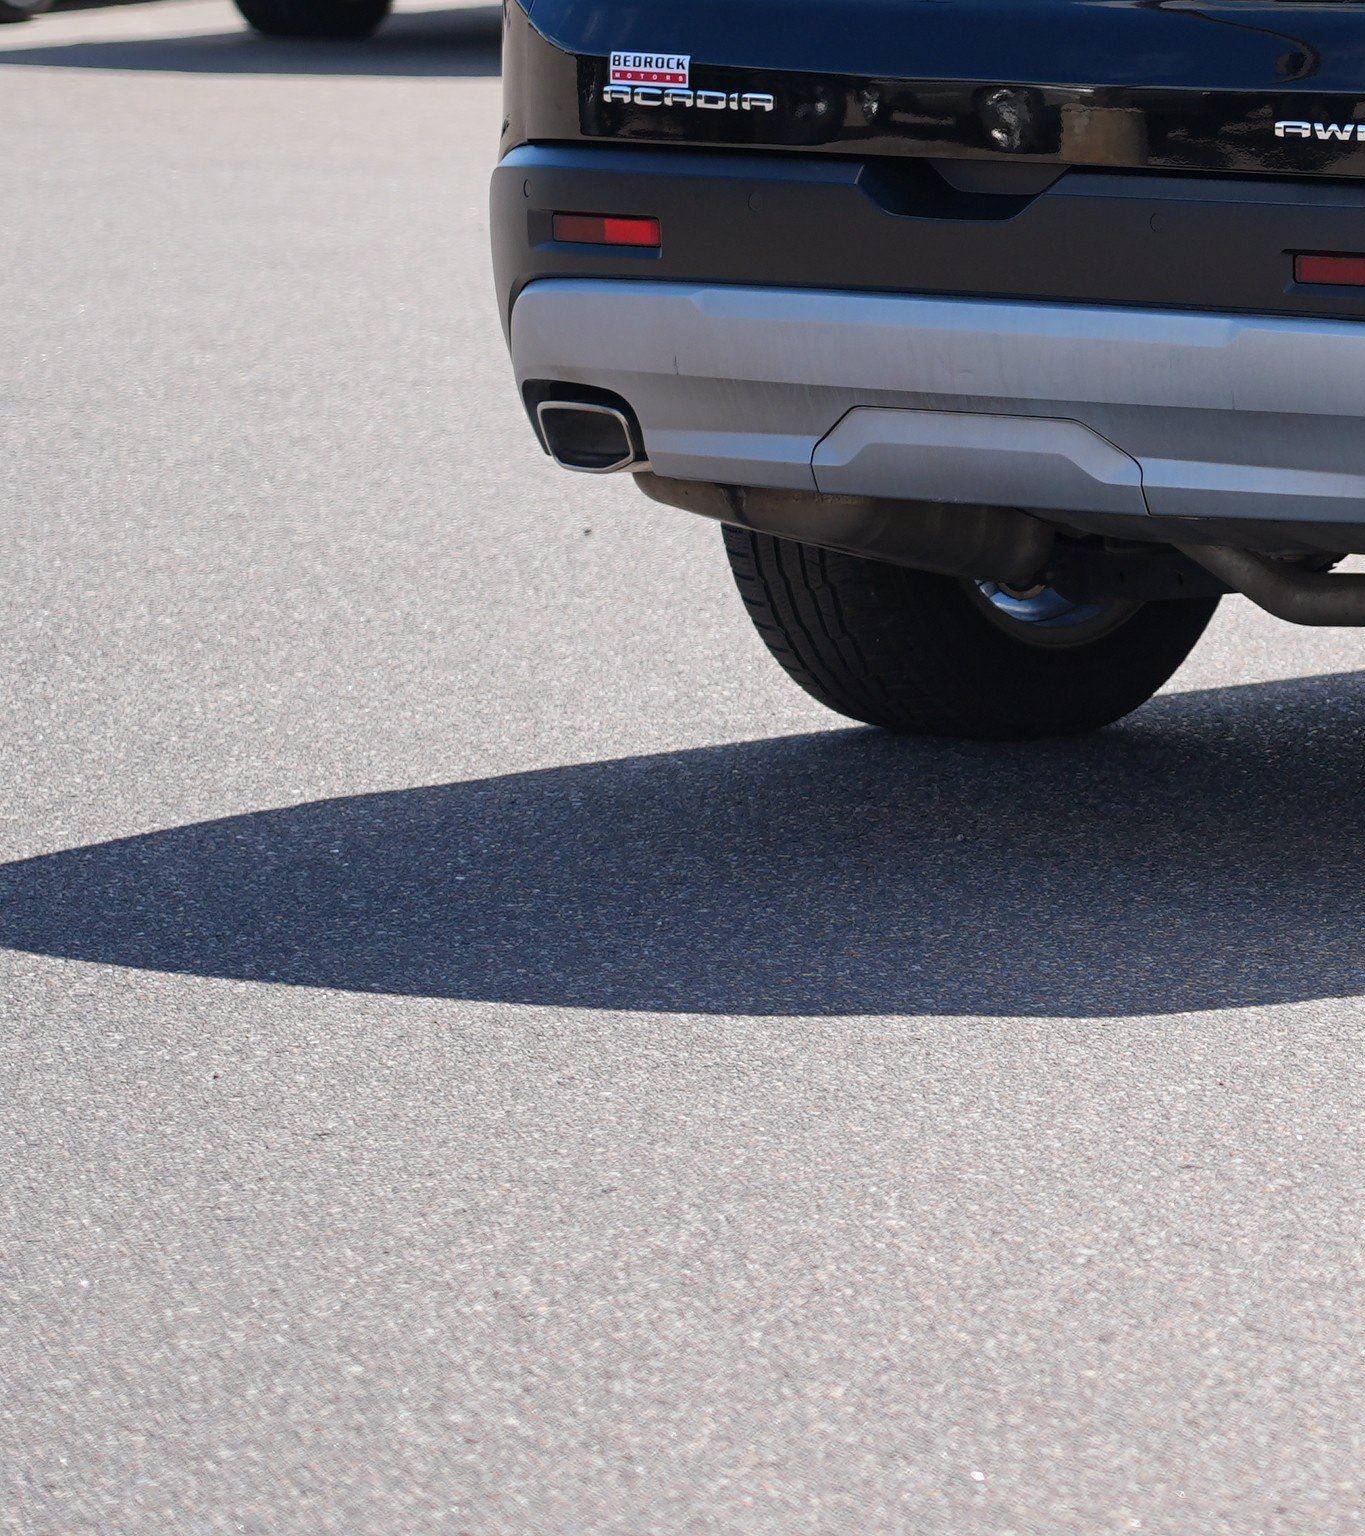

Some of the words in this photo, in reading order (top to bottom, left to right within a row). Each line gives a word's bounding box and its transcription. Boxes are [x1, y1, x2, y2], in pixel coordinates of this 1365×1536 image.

[612, 54, 686, 70] BEDROCK
[614, 72, 684, 82] MOTORS
[602, 85, 775, 113] ACADIA
